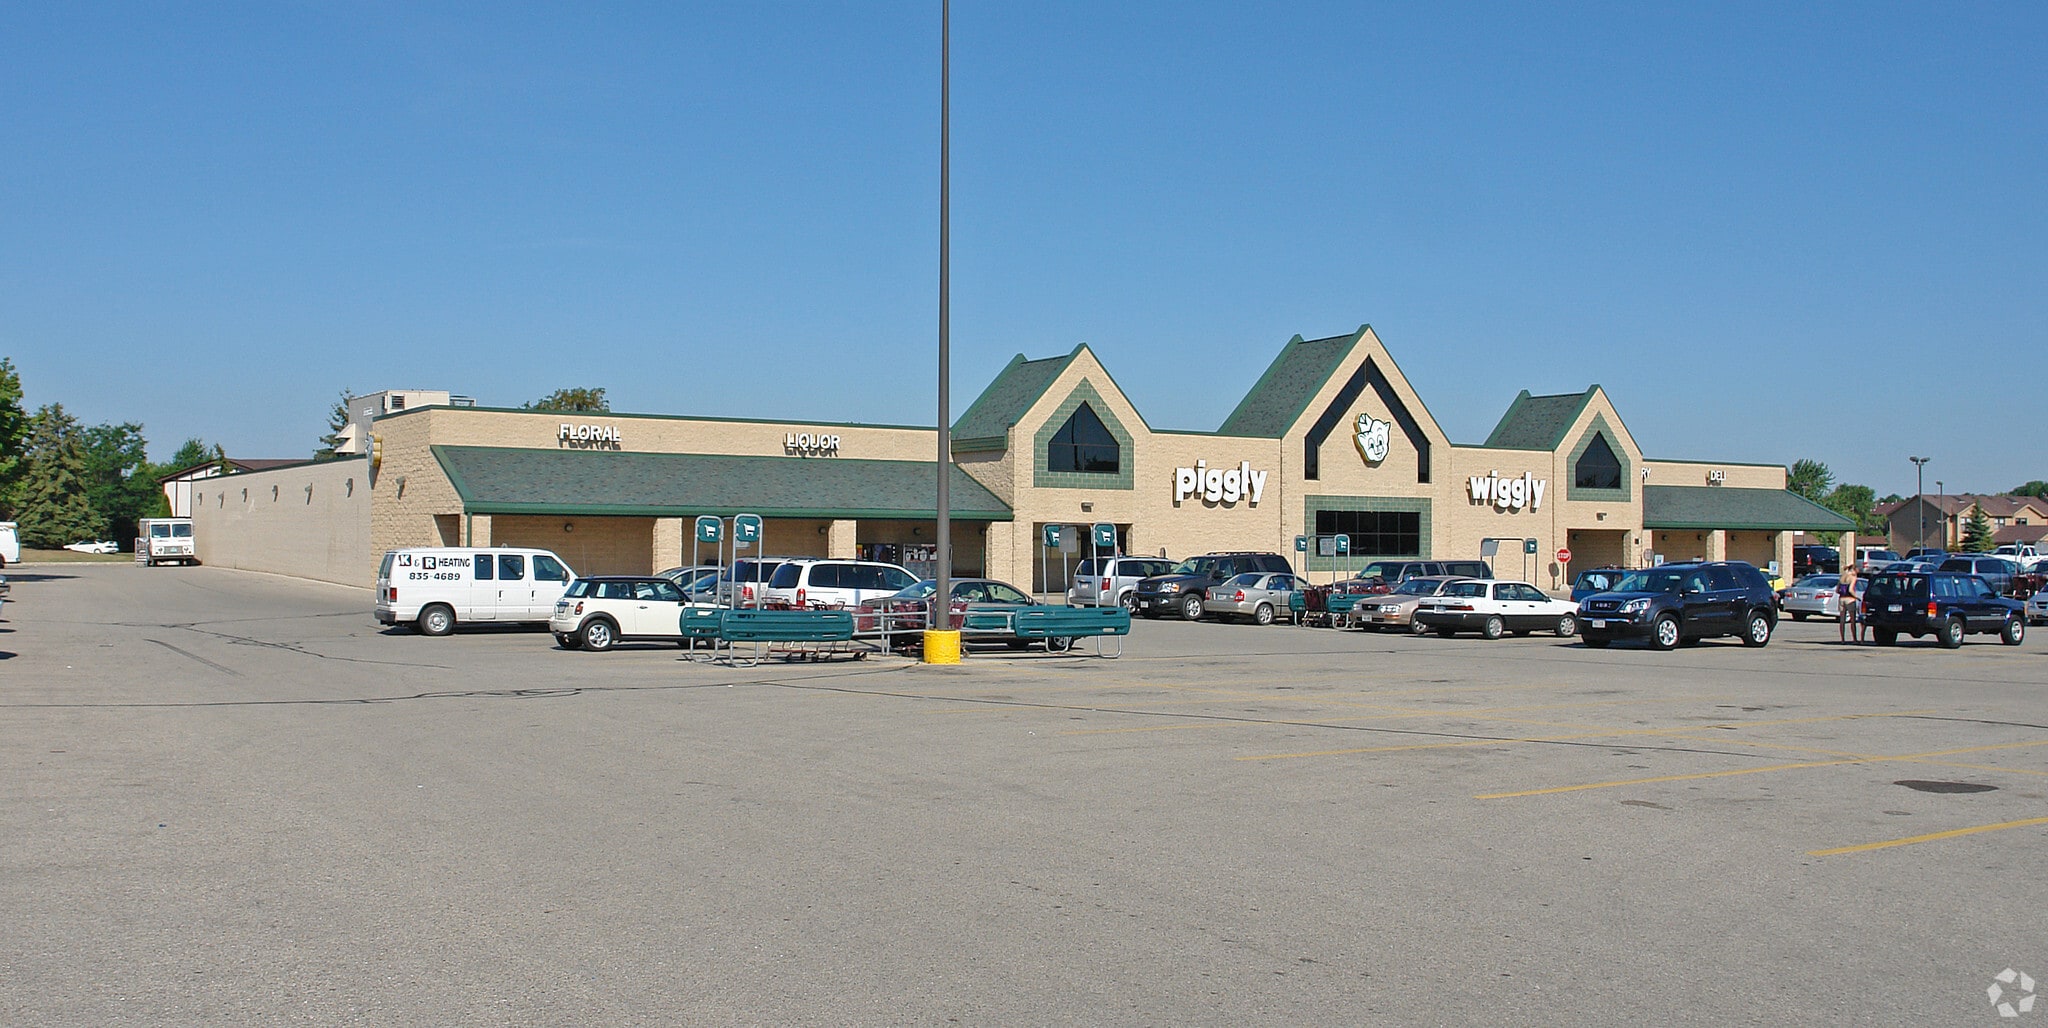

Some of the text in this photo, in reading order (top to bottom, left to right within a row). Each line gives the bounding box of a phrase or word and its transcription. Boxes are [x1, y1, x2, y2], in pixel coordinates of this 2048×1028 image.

[559, 423, 622, 441] FLORAL
[786, 432, 841, 451] LIQUOR
[1710, 470, 1727, 481] DELI
[1175, 459, 1547, 509] piggly wiggly
[399, 555, 471, 569] K & R HEATING
[409, 572, 461, 580] 835-4689
